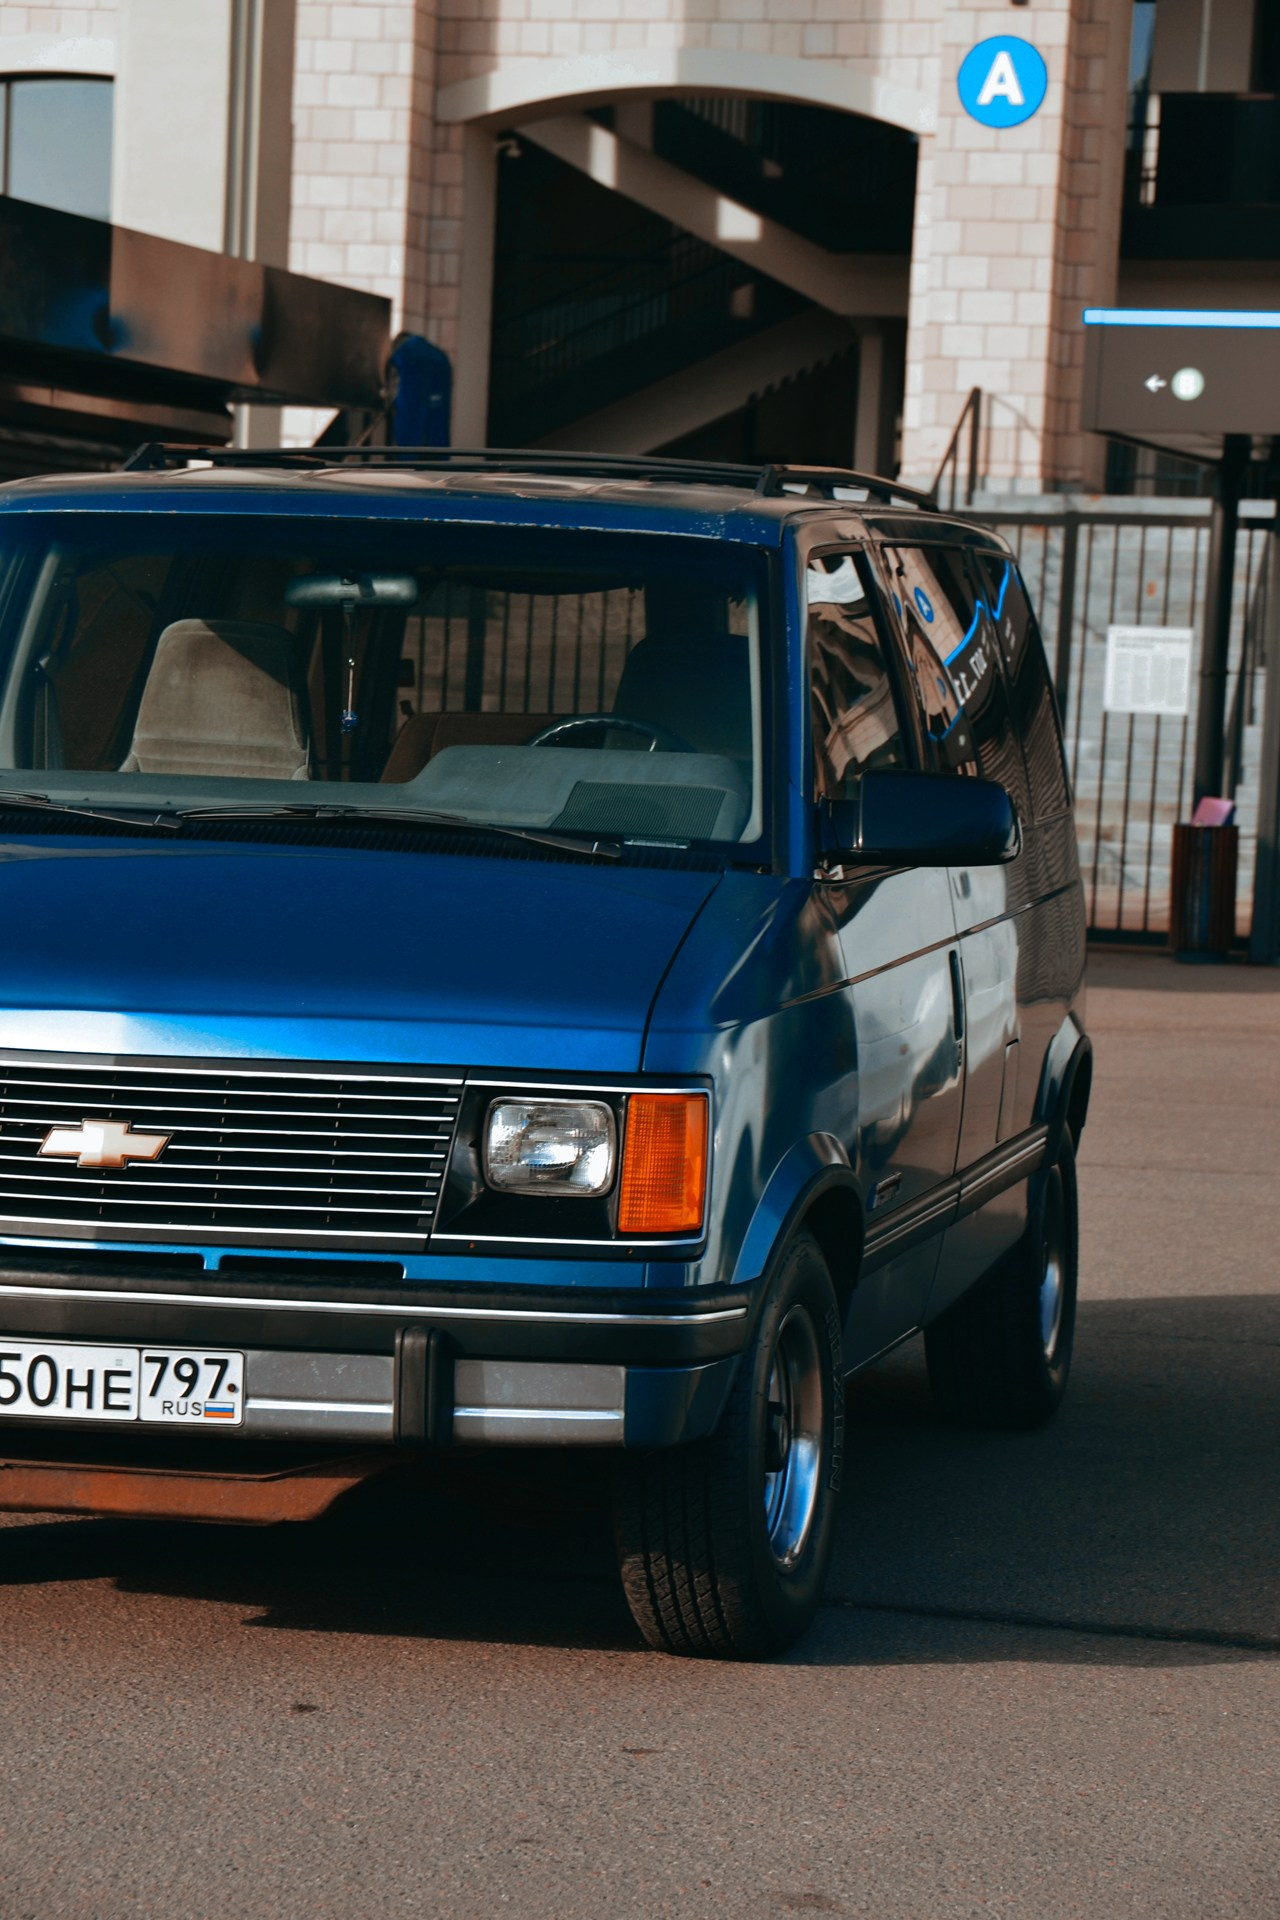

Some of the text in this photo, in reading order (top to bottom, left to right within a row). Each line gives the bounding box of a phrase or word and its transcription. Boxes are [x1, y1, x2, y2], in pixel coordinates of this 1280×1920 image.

[976, 51, 1025, 105] A
[145, 1356, 229, 1399] 797
[825, 1304, 844, 1492] NEXEN
[162, 1401, 202, 1416] RUS
